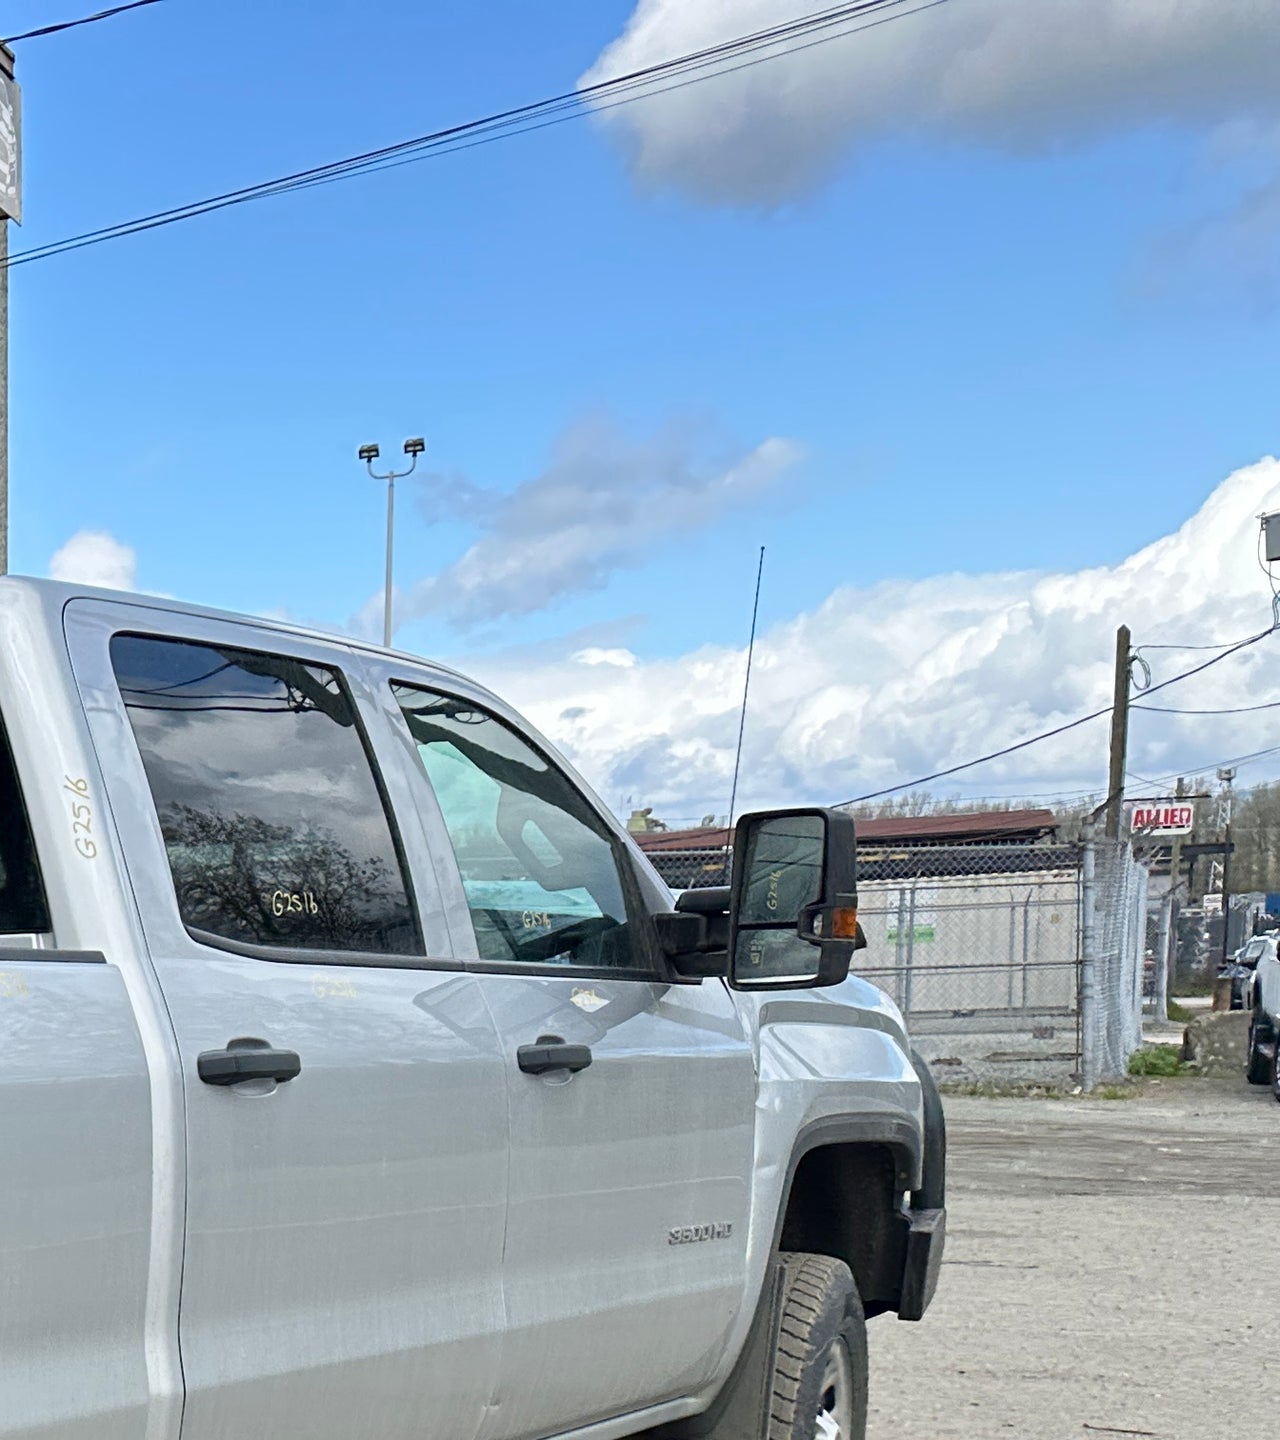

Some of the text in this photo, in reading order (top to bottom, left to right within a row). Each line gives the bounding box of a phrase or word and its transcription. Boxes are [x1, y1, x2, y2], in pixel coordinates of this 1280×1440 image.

[64, 774, 97, 859] G2516
[1133, 808, 1191, 826] ALLIED
[272, 890, 319, 917] G2516
